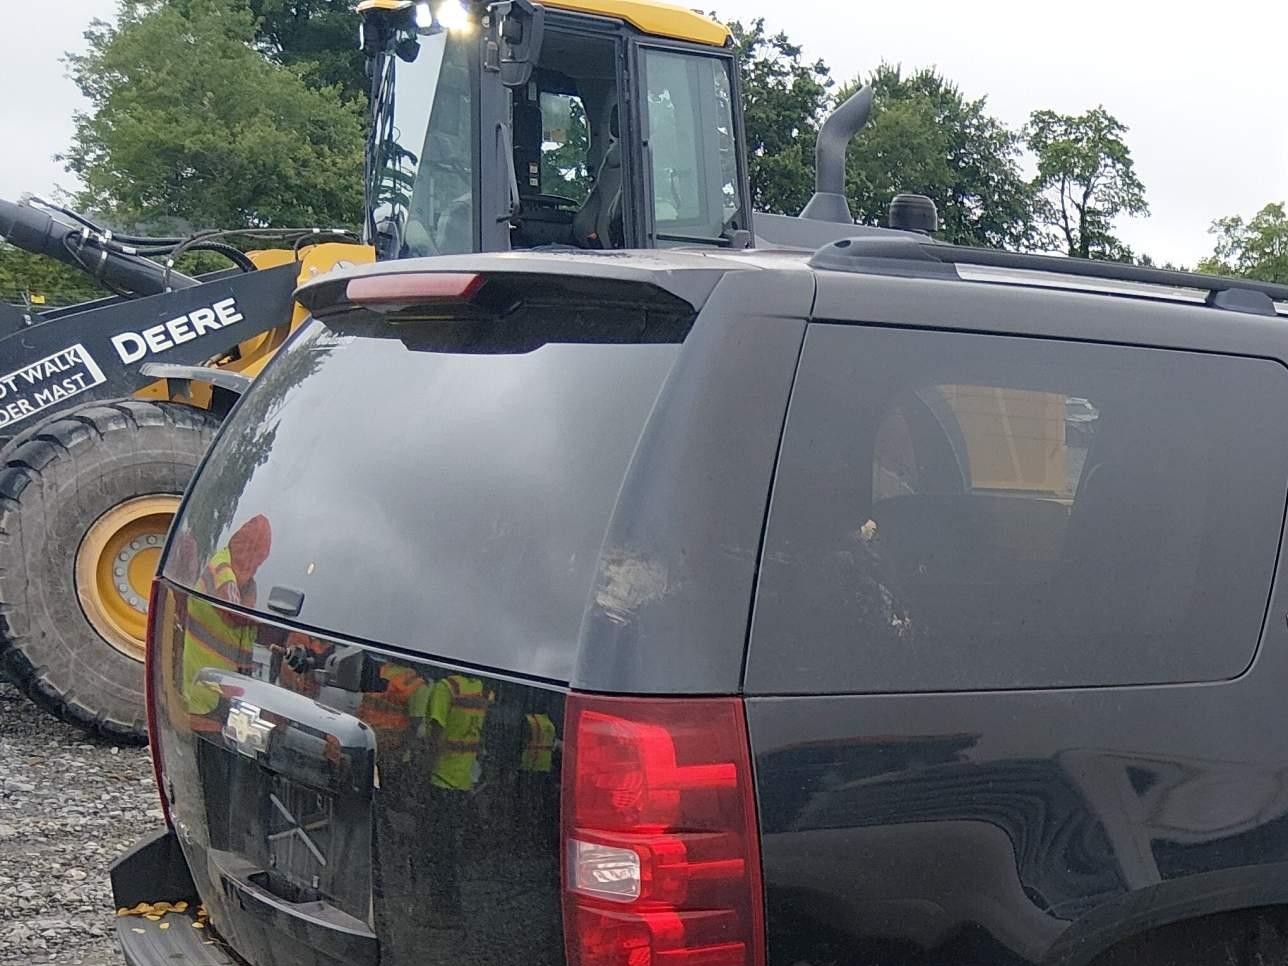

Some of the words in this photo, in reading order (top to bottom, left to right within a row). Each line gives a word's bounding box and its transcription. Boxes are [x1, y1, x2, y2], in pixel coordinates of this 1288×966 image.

[110, 298, 244, 364] DEERE
[20, 349, 82, 384] WALK
[33, 372, 87, 406] MAST
